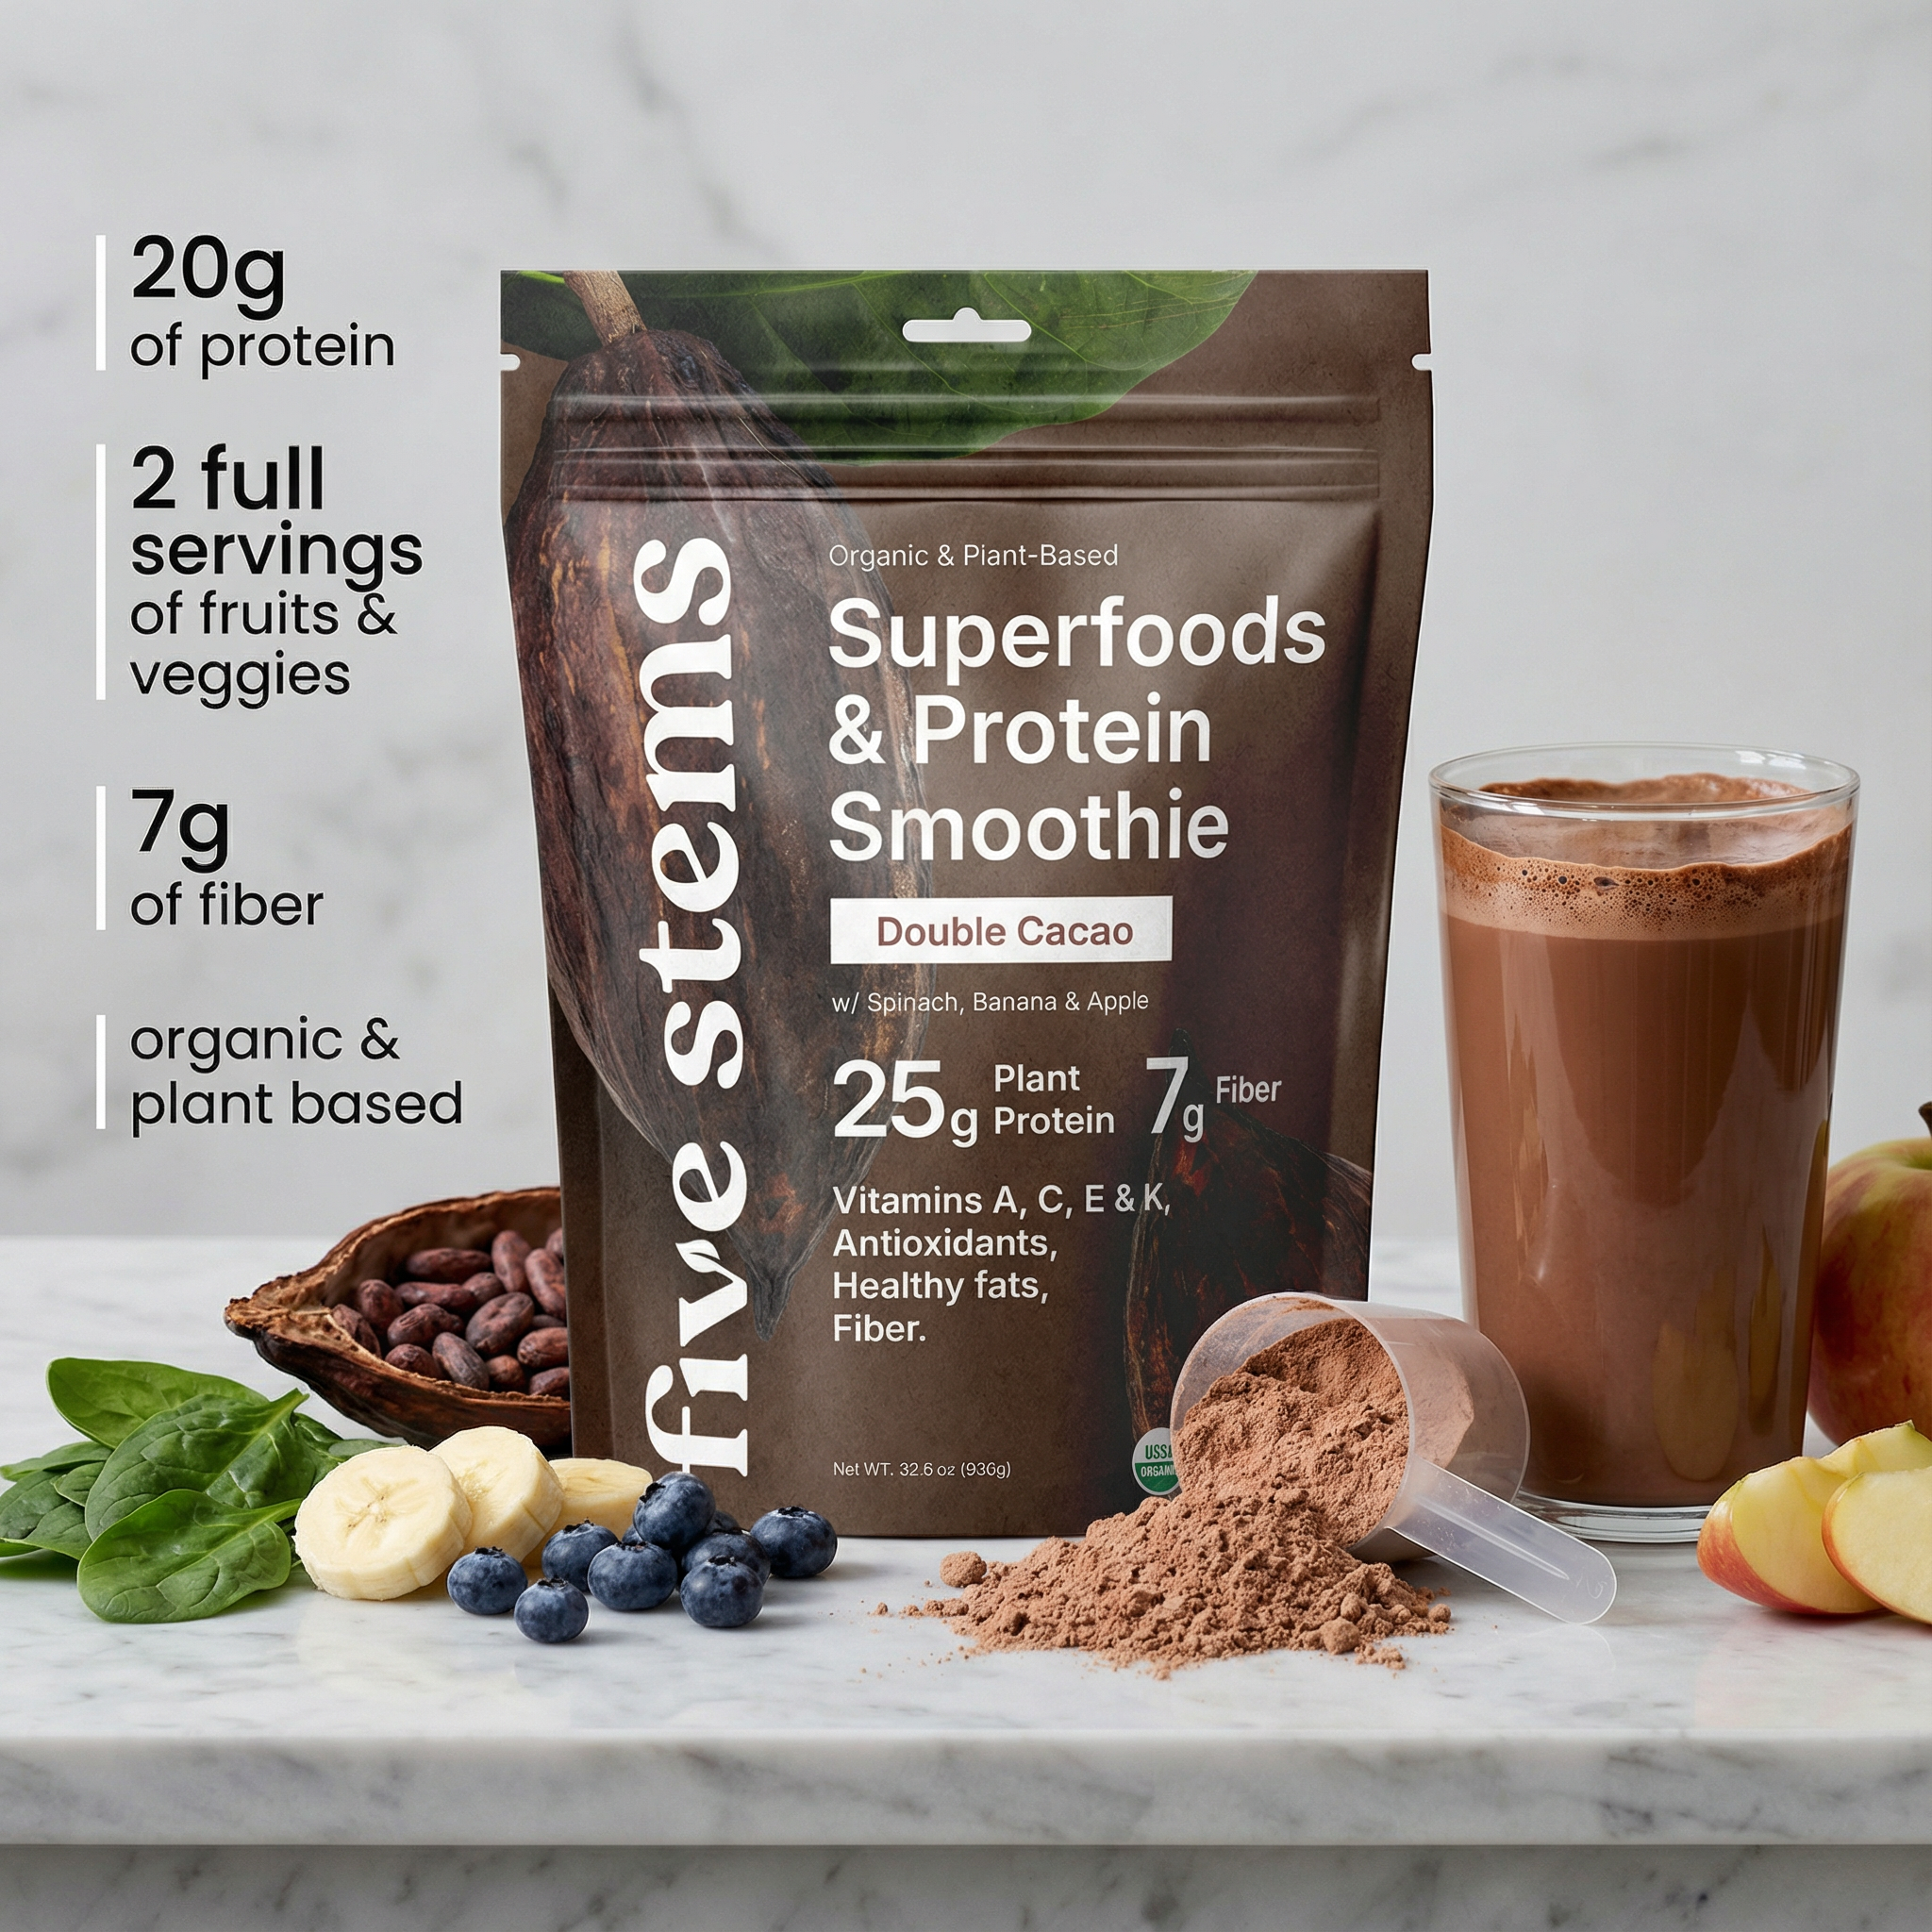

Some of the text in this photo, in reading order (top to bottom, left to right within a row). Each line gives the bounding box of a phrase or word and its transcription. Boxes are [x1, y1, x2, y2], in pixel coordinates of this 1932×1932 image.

[829, 544, 927, 572] Organic
[938, 544, 954, 566] &
[829, 595, 1326, 686] Superfoods
[828, 691, 1210, 764] & Protein
[830, 788, 1229, 861] Smoothie
[878, 916, 1133, 946] Double Cacao
[633, 537, 748, 1477] five stems
[832, 990, 1149, 1016] w/ Spinach, Banana & Apple
[995, 1064, 1080, 1091] Plant
[1217, 1075, 1282, 1103] Fiber
[834, 1059, 976, 1147] 25g
[1147, 1057, 1204, 1142] 7g
[995, 1106, 1114, 1134] Protein
[833, 1183, 1170, 1220] Vitamins A, C, E & K,
[833, 1228, 1057, 1261] Antioxidants,
[834, 1270, 1047, 1306] Healthy fats,
[834, 1314, 925, 1341] Fiber.
[834, 1461, 1012, 1479] Net WT. 32.6 oz (936g)
[1141, 1464, 1176, 1477] ORGANI
